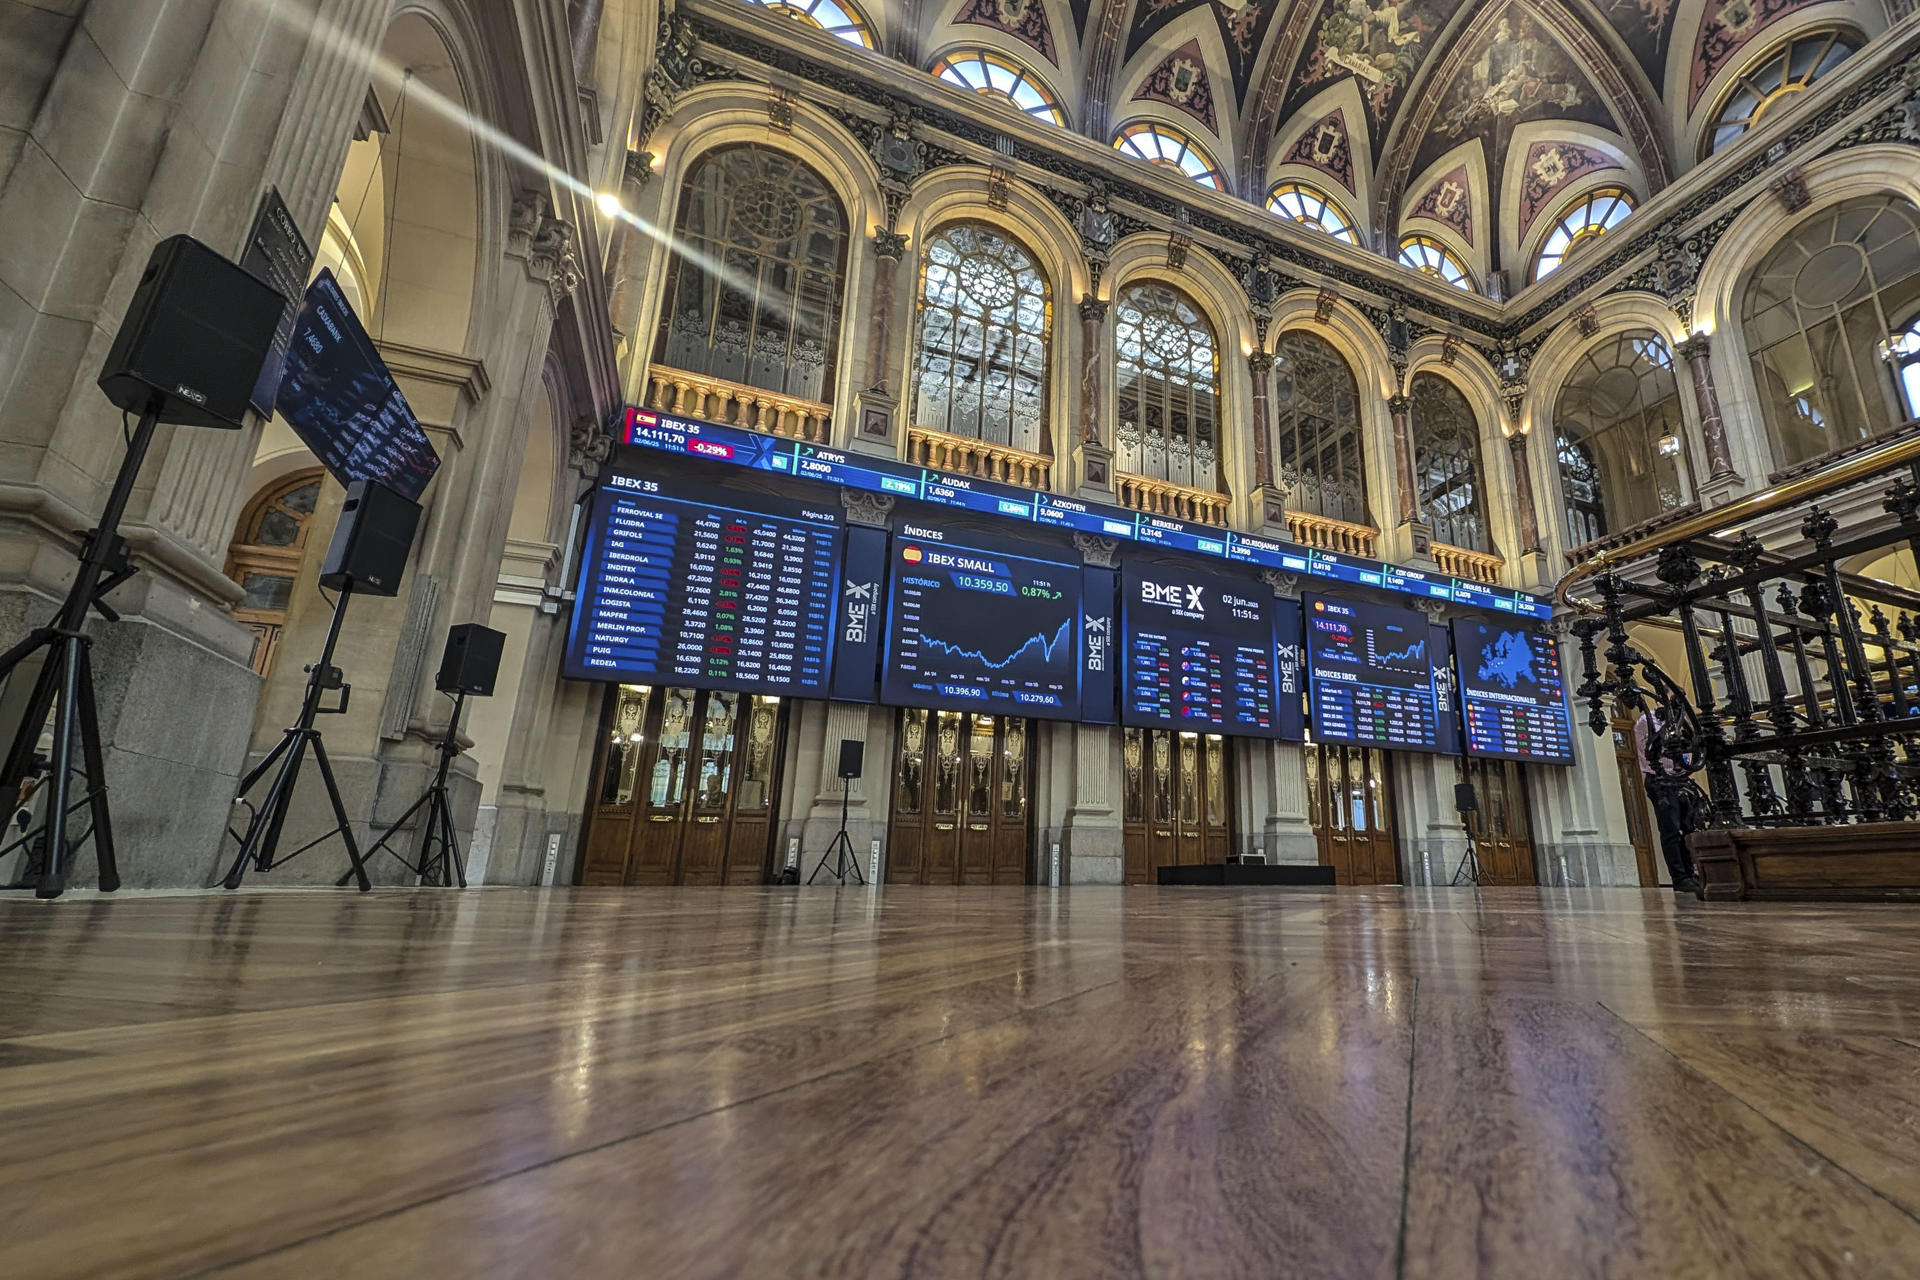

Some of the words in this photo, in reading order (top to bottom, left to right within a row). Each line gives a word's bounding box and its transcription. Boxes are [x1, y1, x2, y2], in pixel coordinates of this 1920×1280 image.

[316, 305, 342, 343] CAIXABANK
[661, 419, 686, 432] IBEX
[687, 424, 700, 434] 35
[636, 427, 684, 444] 14.111,70
[634, 437, 659, 447] 02/06/25
[694, 443, 727, 456] -0,29%
[817, 452, 845, 464] ATRYS
[802, 460, 831, 473] 2,8000
[611, 475, 641, 489] IBEX
[643, 481, 658, 491] 35
[942, 477, 970, 489] AUDAX
[929, 486, 954, 498] 1,6360
[1052, 500, 1086, 512] AZKOYEN
[617, 506, 654, 519] FERROVIAL
[696, 520, 720, 528] 44,4700
[802, 510, 823, 520] Página
[615, 518, 644, 528] FLUIDRA
[1152, 519, 1183, 531] BERKELEY
[904, 524, 943, 540] ÍNDICES
[613, 530, 642, 539] GRIFOLS
[696, 542, 717, 550] 9,6240
[694, 553, 715, 561] 3,9110
[928, 553, 955, 567] IBEX
[957, 557, 995, 573] SMALL
[609, 552, 649, 563] IBERDROLA
[749, 572, 771, 580] 16,2100
[605, 575, 627, 583] INDRA
[607, 563, 636, 573] INDITEX
[746, 582, 770, 591] 47,4400
[902, 576, 940, 588] HISTÓRICO
[959, 576, 1008, 593] 10.359,50
[603, 587, 654, 598] INM.COLONIAL
[1022, 587, 1050, 598] 0,87%
[1142, 581, 1182, 604] BME
[601, 599, 631, 608] LOGISTA
[1222, 595, 1232, 603] 02
[599, 610, 628, 619] MAPFRE
[1184, 610, 1204, 620] company
[597, 622, 625, 631] MERLIN
[626, 626, 646, 634] PROP.
[846, 602, 865, 642] BME
[1316, 621, 1347, 632] 14.111,70
[595, 635, 629, 644] NATURGY
[1088, 634, 1101, 670] BME
[591, 659, 616, 667] REDEIA
[1281, 661, 1293, 693] BME
[1315, 668, 1341, 679] ÍNDICES
[1342, 673, 1357, 681] IBEX
[945, 686, 980, 696] 10.396,90
[1436, 682, 1448, 712] BME
[1466, 688, 1488, 698] ÍNDICES
[1489, 692, 1536, 704] INTERNACIONALES
[1020, 694, 1054, 703] 10.279,60
